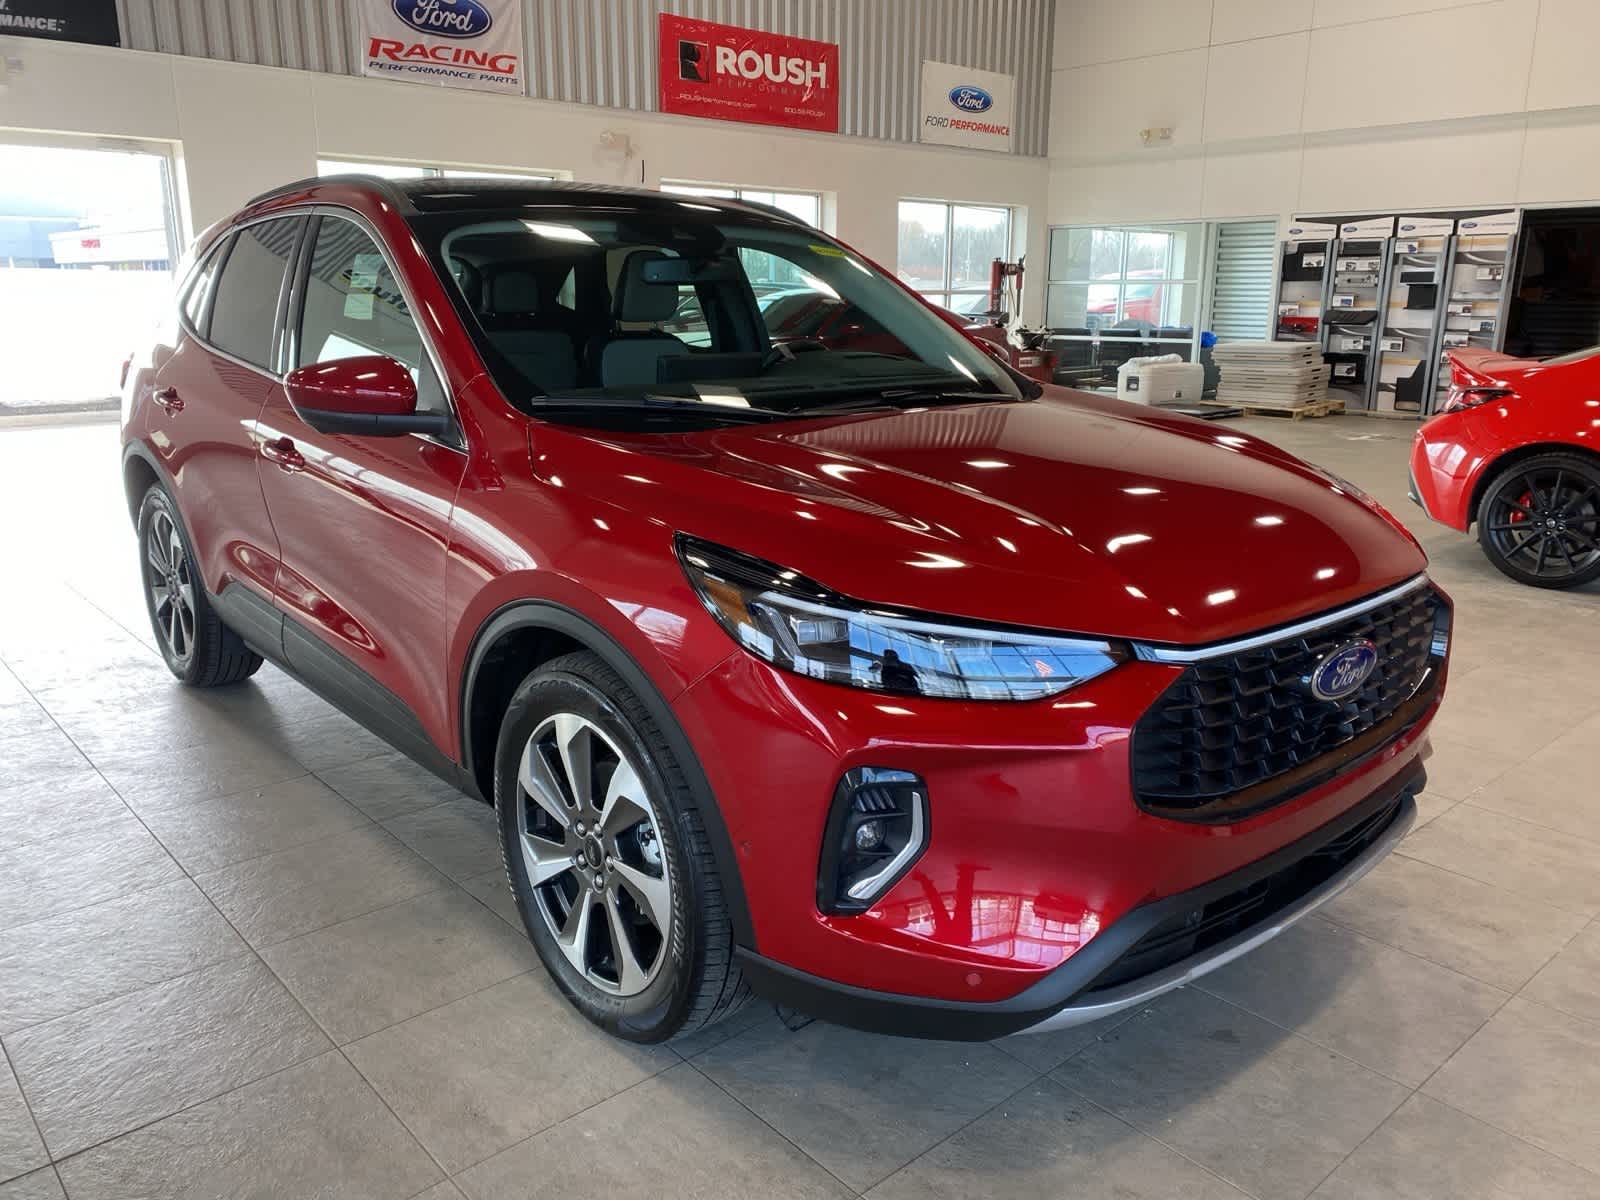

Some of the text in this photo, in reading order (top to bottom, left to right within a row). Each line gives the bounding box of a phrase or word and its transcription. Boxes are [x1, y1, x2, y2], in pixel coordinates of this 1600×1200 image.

[411, 0, 474, 32] Ford
[368, 37, 519, 75] RACING
[716, 46, 827, 89] ROUSH
[369, 61, 519, 85] PERFORMANCE PARTS
[957, 89, 985, 109] Ford
[925, 115, 1010, 137] FORD PERFORMANCE
[1331, 653, 1368, 690] Ford
